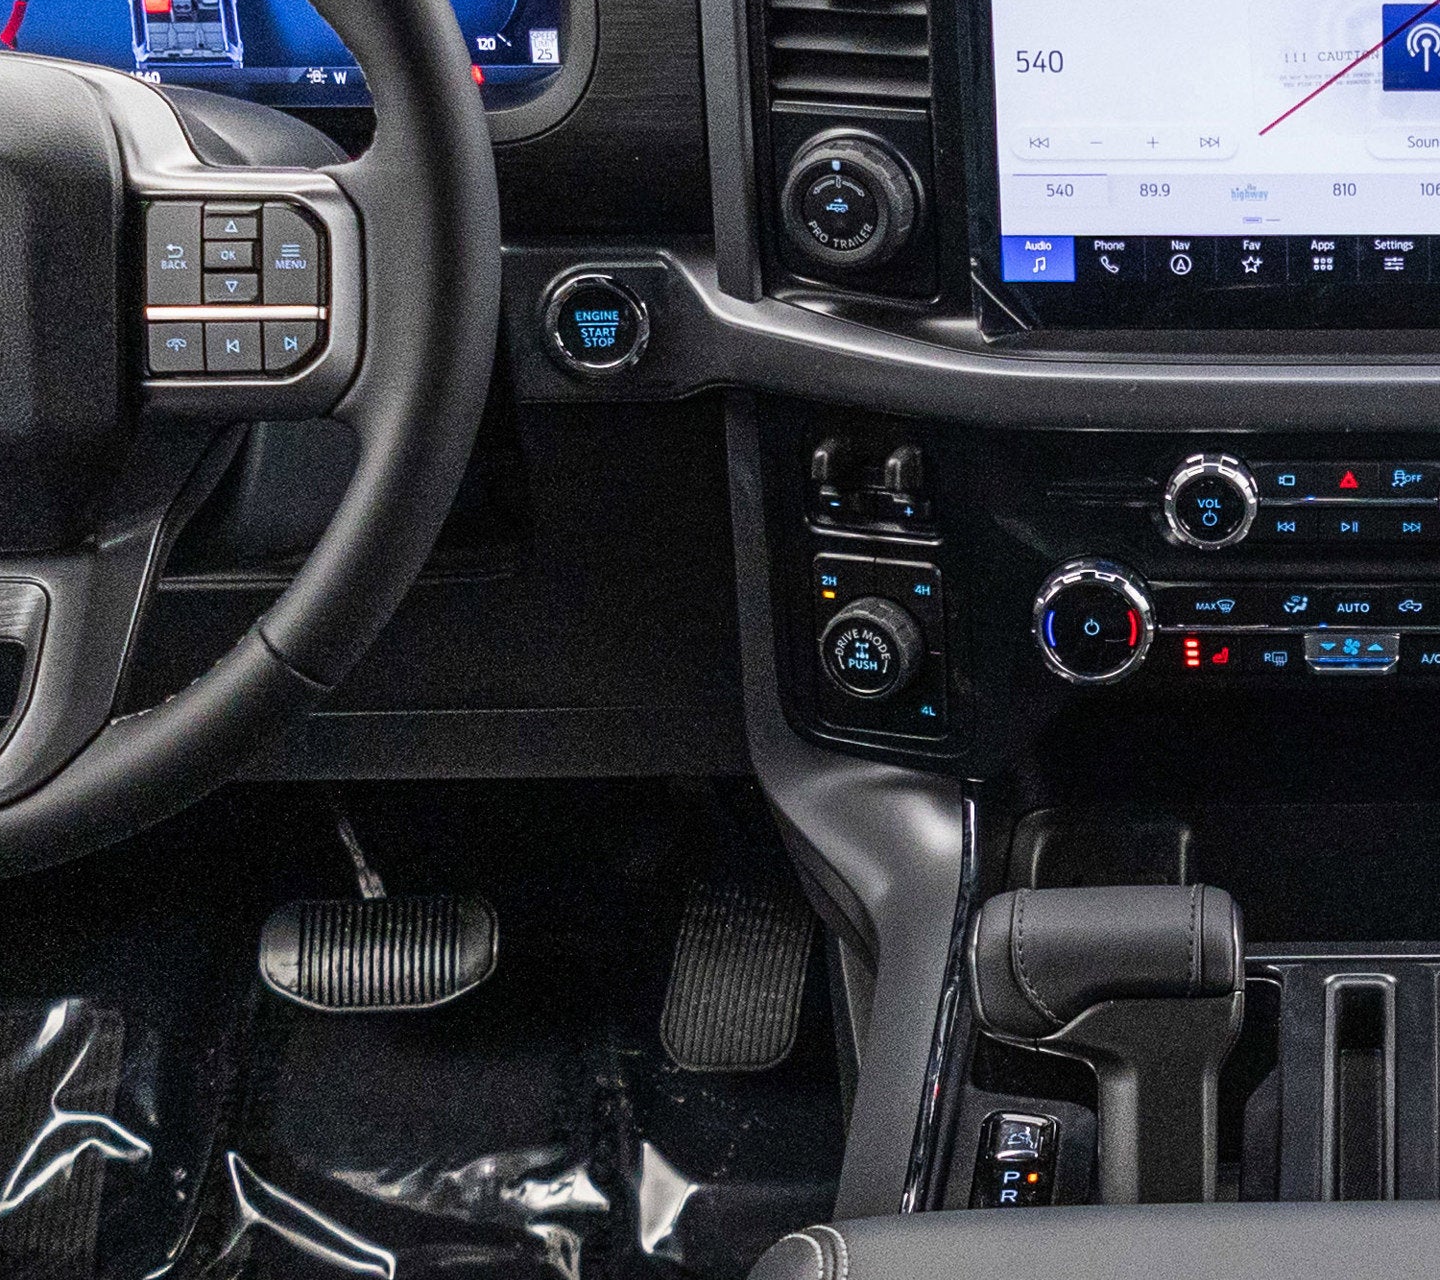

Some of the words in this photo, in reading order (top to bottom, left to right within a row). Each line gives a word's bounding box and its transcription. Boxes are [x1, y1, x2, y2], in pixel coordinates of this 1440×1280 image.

[476, 37, 497, 50] 120
[538, 48, 553, 61] 25
[1016, 50, 1063, 73] 540
[333, 72, 347, 84] W
[1046, 183, 1074, 198] 540
[1139, 183, 1171, 198] 89.9
[1332, 183, 1357, 197] 810
[808, 220, 829, 243] PRO
[833, 222, 874, 249] TRAILER
[1024, 240, 1053, 251] Audio
[1094, 240, 1125, 251] Phone
[1171, 240, 1190, 251] Nav
[1242, 240, 1261, 251] Fav
[1311, 240, 1335, 253] Apps
[1374, 239, 1414, 252] Settings
[220, 250, 236, 260] OK
[161, 260, 188, 270] BACK
[275, 260, 307, 270] MENU
[575, 311, 620, 321] ENGINE
[581, 327, 617, 338] START
[584, 337, 615, 348] STOP
[1405, 474, 1422, 483] OFF
[1197, 498, 1221, 509] VOL
[821, 575, 838, 587] 2H
[914, 584, 931, 596] 4H
[1196, 601, 1216, 611] MAX
[1337, 602, 1370, 613] AUTO
[835, 629, 859, 656] DRIVE
[862, 629, 891, 660] MODE
[1264, 652, 1272, 663] R
[848, 658, 878, 671] PUSH
[921, 705, 936, 717] 4L
[1003, 1171, 1021, 1184] P
[1000, 1189, 1018, 1203] R
